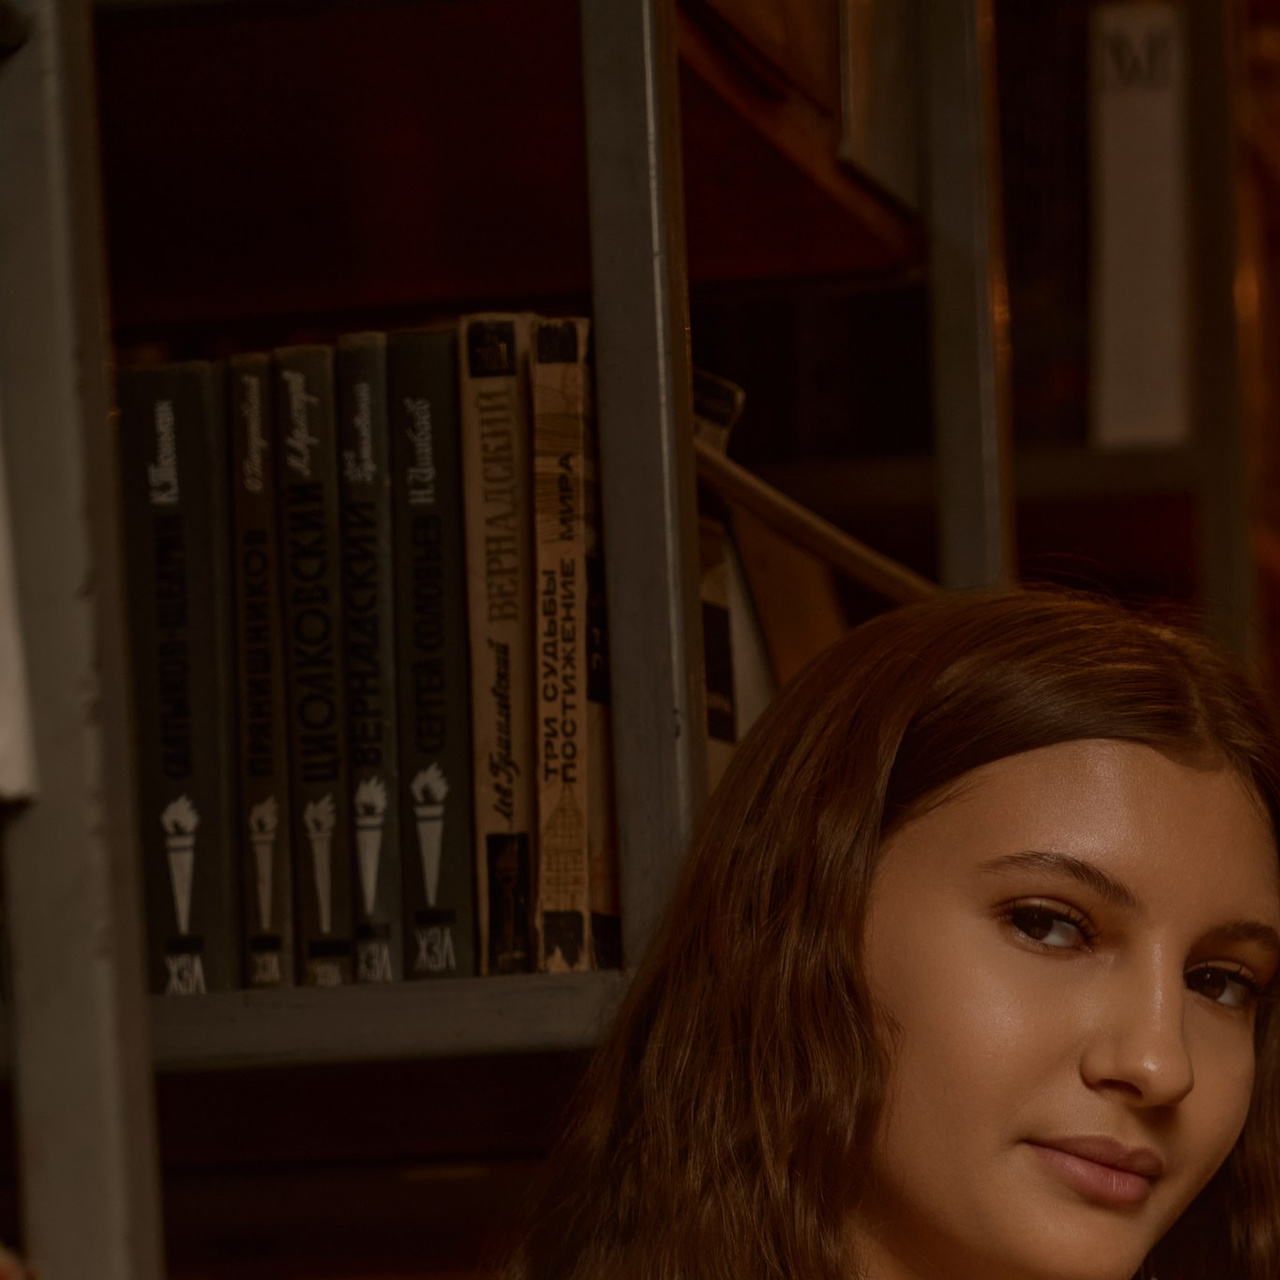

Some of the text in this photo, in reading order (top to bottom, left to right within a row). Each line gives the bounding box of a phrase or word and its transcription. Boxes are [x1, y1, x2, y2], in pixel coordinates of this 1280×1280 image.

[477, 389, 519, 623] ВЕРНАДСКИЙ
[557, 451, 578, 784] ПОСТИЖЕНИЕ МИРА
[155, 513, 192, 780] САЛТЫКОВ-ЩЕДРИН
[244, 528, 273, 777] ПРЯНИШНИКОВ
[288, 481, 341, 783] ЦИОЛКОВСКИЙ
[344, 501, 383, 768] ВЕРНАДСКИЙ
[413, 514, 446, 756] СЕРГЕЙ СОЛОВЬЕВ
[541, 569, 560, 783] ТРИ СУДЬБЫ
[165, 954, 206, 995] ЖЗЛ
[357, 943, 392, 982] ЖЗЛ
[413, 926, 455, 972] ЖЗЛ
